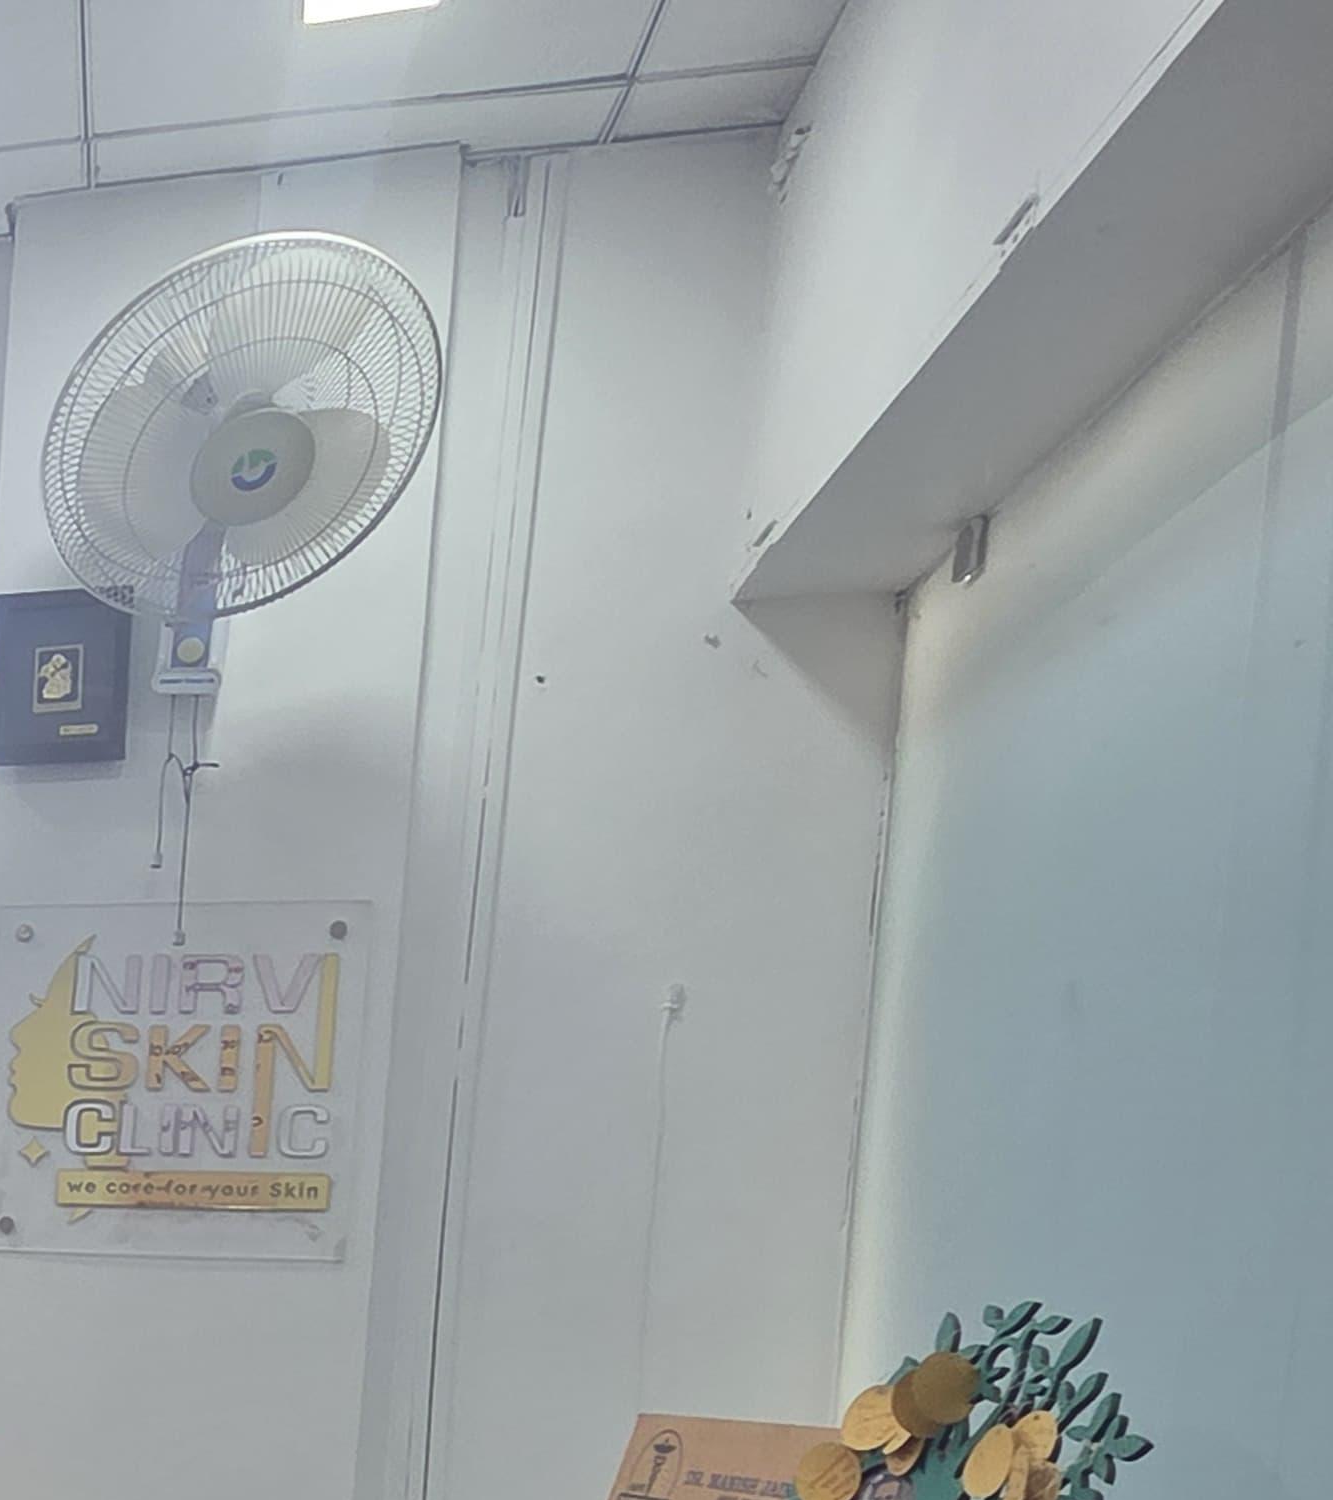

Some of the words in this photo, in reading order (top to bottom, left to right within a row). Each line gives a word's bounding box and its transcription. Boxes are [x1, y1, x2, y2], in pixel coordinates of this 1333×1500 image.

[71, 952, 324, 1015] NIRV
[64, 1097, 330, 1159] CLINIC
[67, 1180, 97, 1194] we
[105, 1181, 155, 1195] care
[207, 1183, 260, 1200] your
[269, 1181, 319, 1199] Skin
